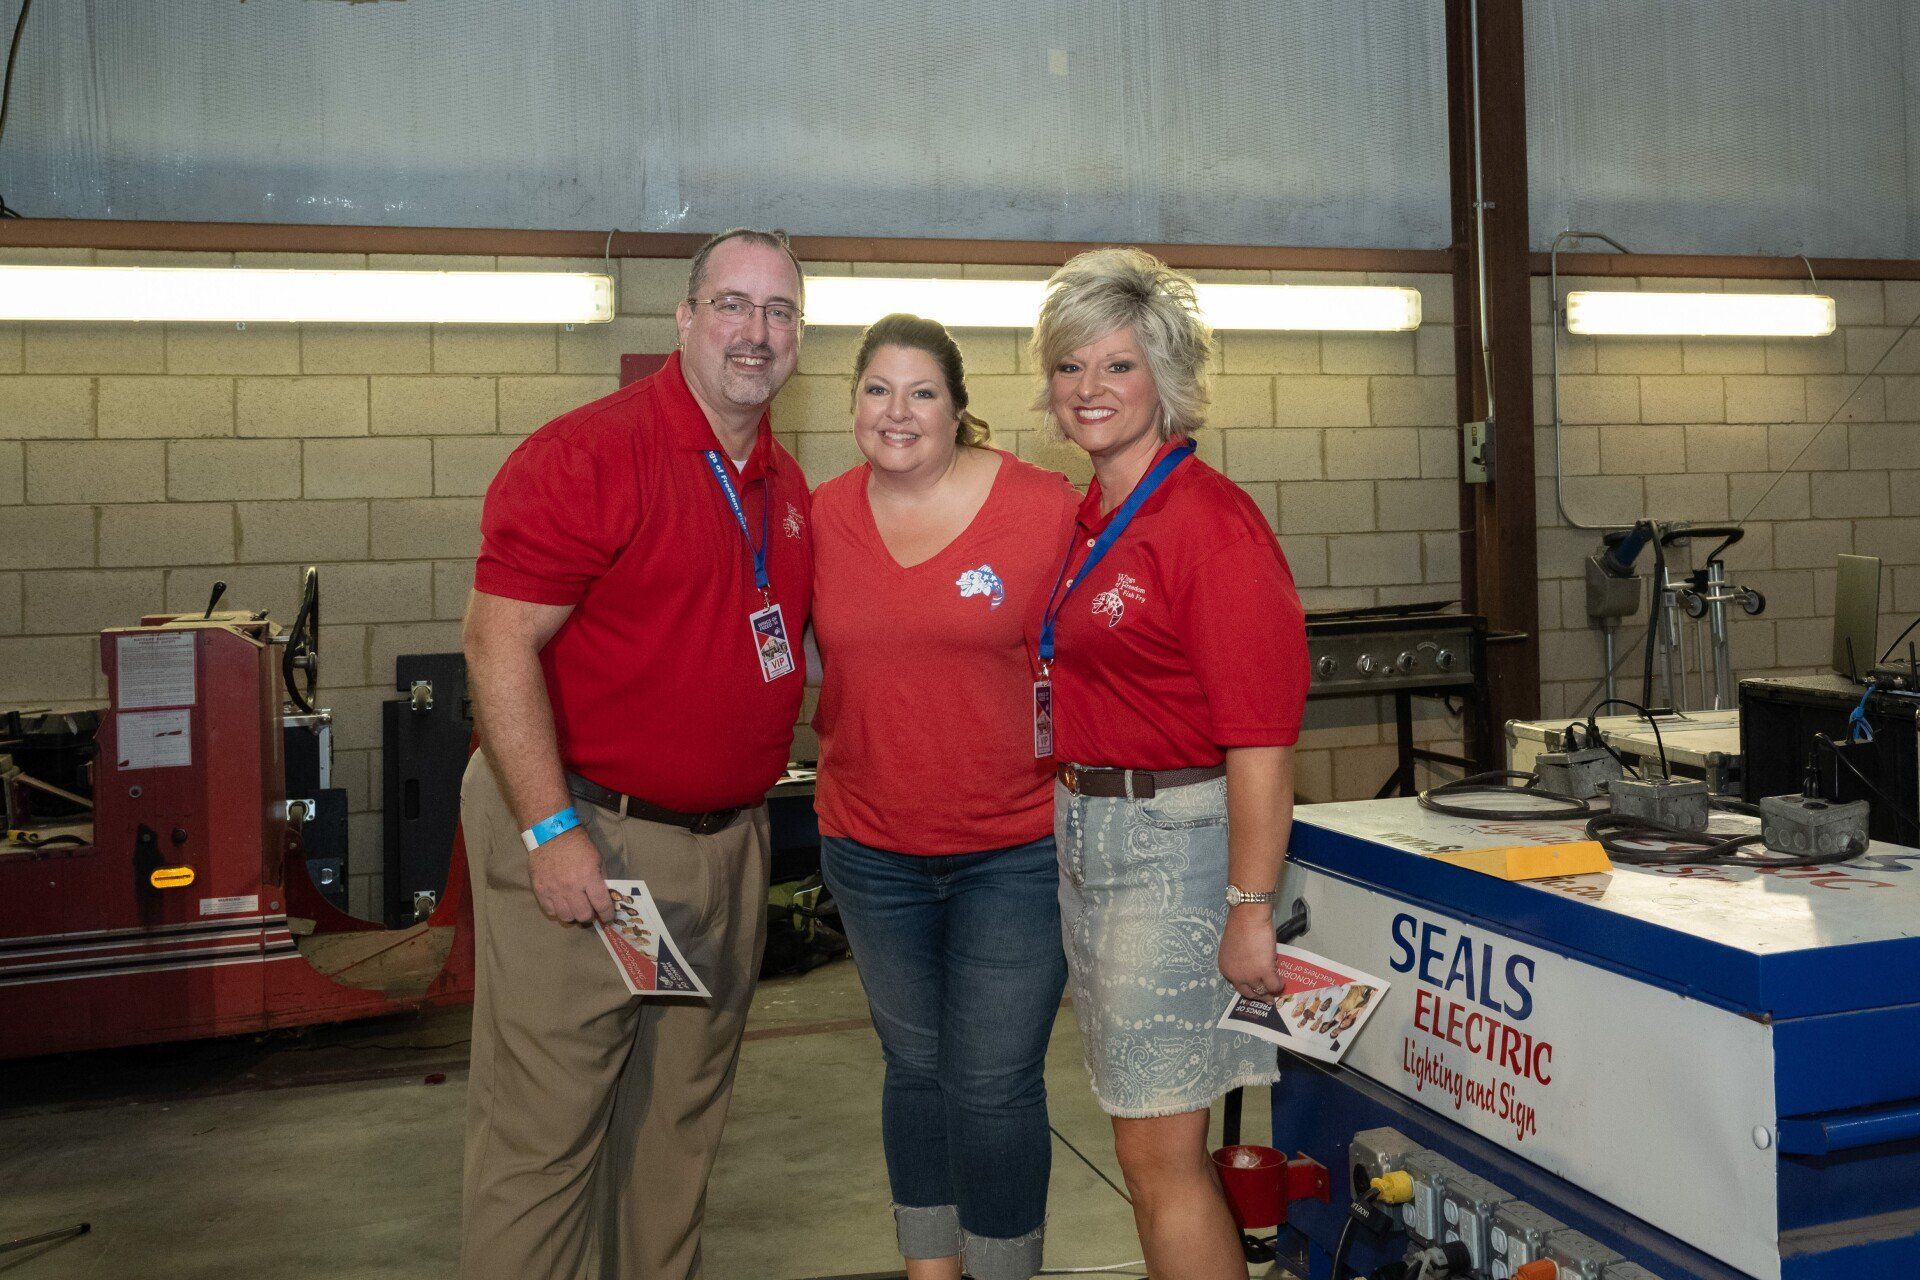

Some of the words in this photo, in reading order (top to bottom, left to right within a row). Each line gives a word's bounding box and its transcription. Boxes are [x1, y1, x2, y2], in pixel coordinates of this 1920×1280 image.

[715, 464, 724, 473] of
[720, 474, 740, 511] Freedom
[1122, 589, 1135, 599] Fish
[771, 658, 785, 669] VIP
[1279, 960, 1295, 971] The
[1293, 964, 1304, 972] of
[1389, 912, 1536, 1021] SEALS
[1275, 968, 1318, 988] HONORIN
[1304, 966, 1337, 987] Teachers
[1240, 999, 1272, 1012] FREEDM
[1246, 1007, 1269, 1018] WINGS
[1413, 988, 1553, 1086] ELECTRIC
[1403, 1037, 1463, 1110] Lighting
[1465, 1077, 1496, 1114] and
[1498, 1081, 1537, 1141] Sign
